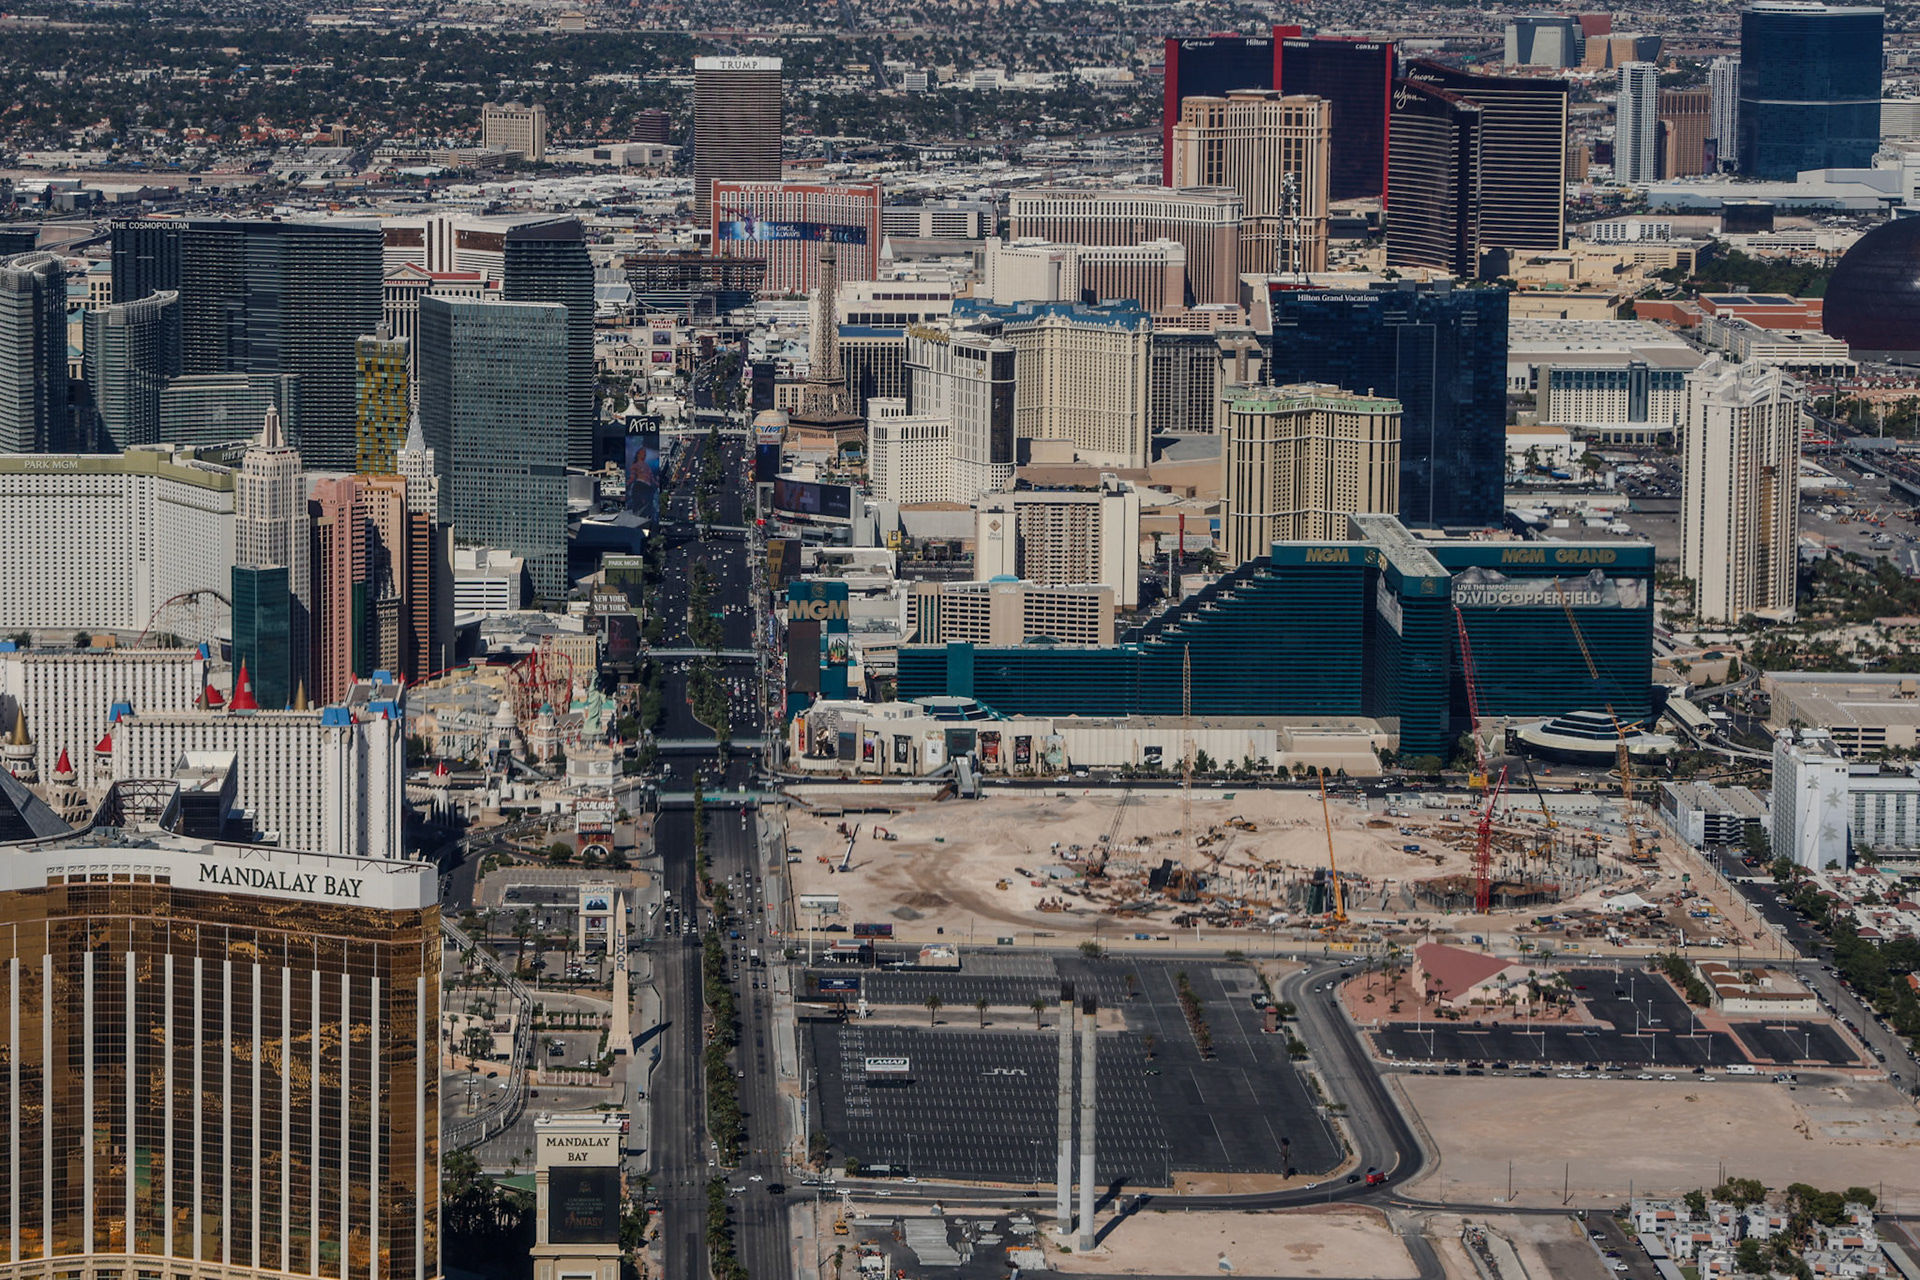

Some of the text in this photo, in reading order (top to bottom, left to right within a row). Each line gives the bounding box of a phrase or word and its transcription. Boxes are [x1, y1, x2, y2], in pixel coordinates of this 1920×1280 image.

[720, 60, 758, 69] TRUMP
[112, 222, 190, 230] THE COSMOPOLITAN
[629, 418, 657, 433] Aria
[24, 460, 78, 469] PARK MGM
[1305, 548, 1350, 563] MGM
[1502, 549, 1617, 564] MGM GRAND
[594, 594, 626, 603] NEW YORK
[1498, 591, 1601, 605] COPPERFIELD
[594, 604, 626, 612] NEW YORK
[788, 600, 850, 621] MGM
[576, 801, 616, 811] EXCALIBUR
[199, 863, 363, 898] MANDALAY BAY
[580, 886, 613, 894] LUXOR
[616, 929, 626, 972] LUXOR
[546, 1137, 610, 1147] MANDALAY
[567, 1152, 588, 1161] BAY
[565, 1212, 604, 1227] FANTASY
